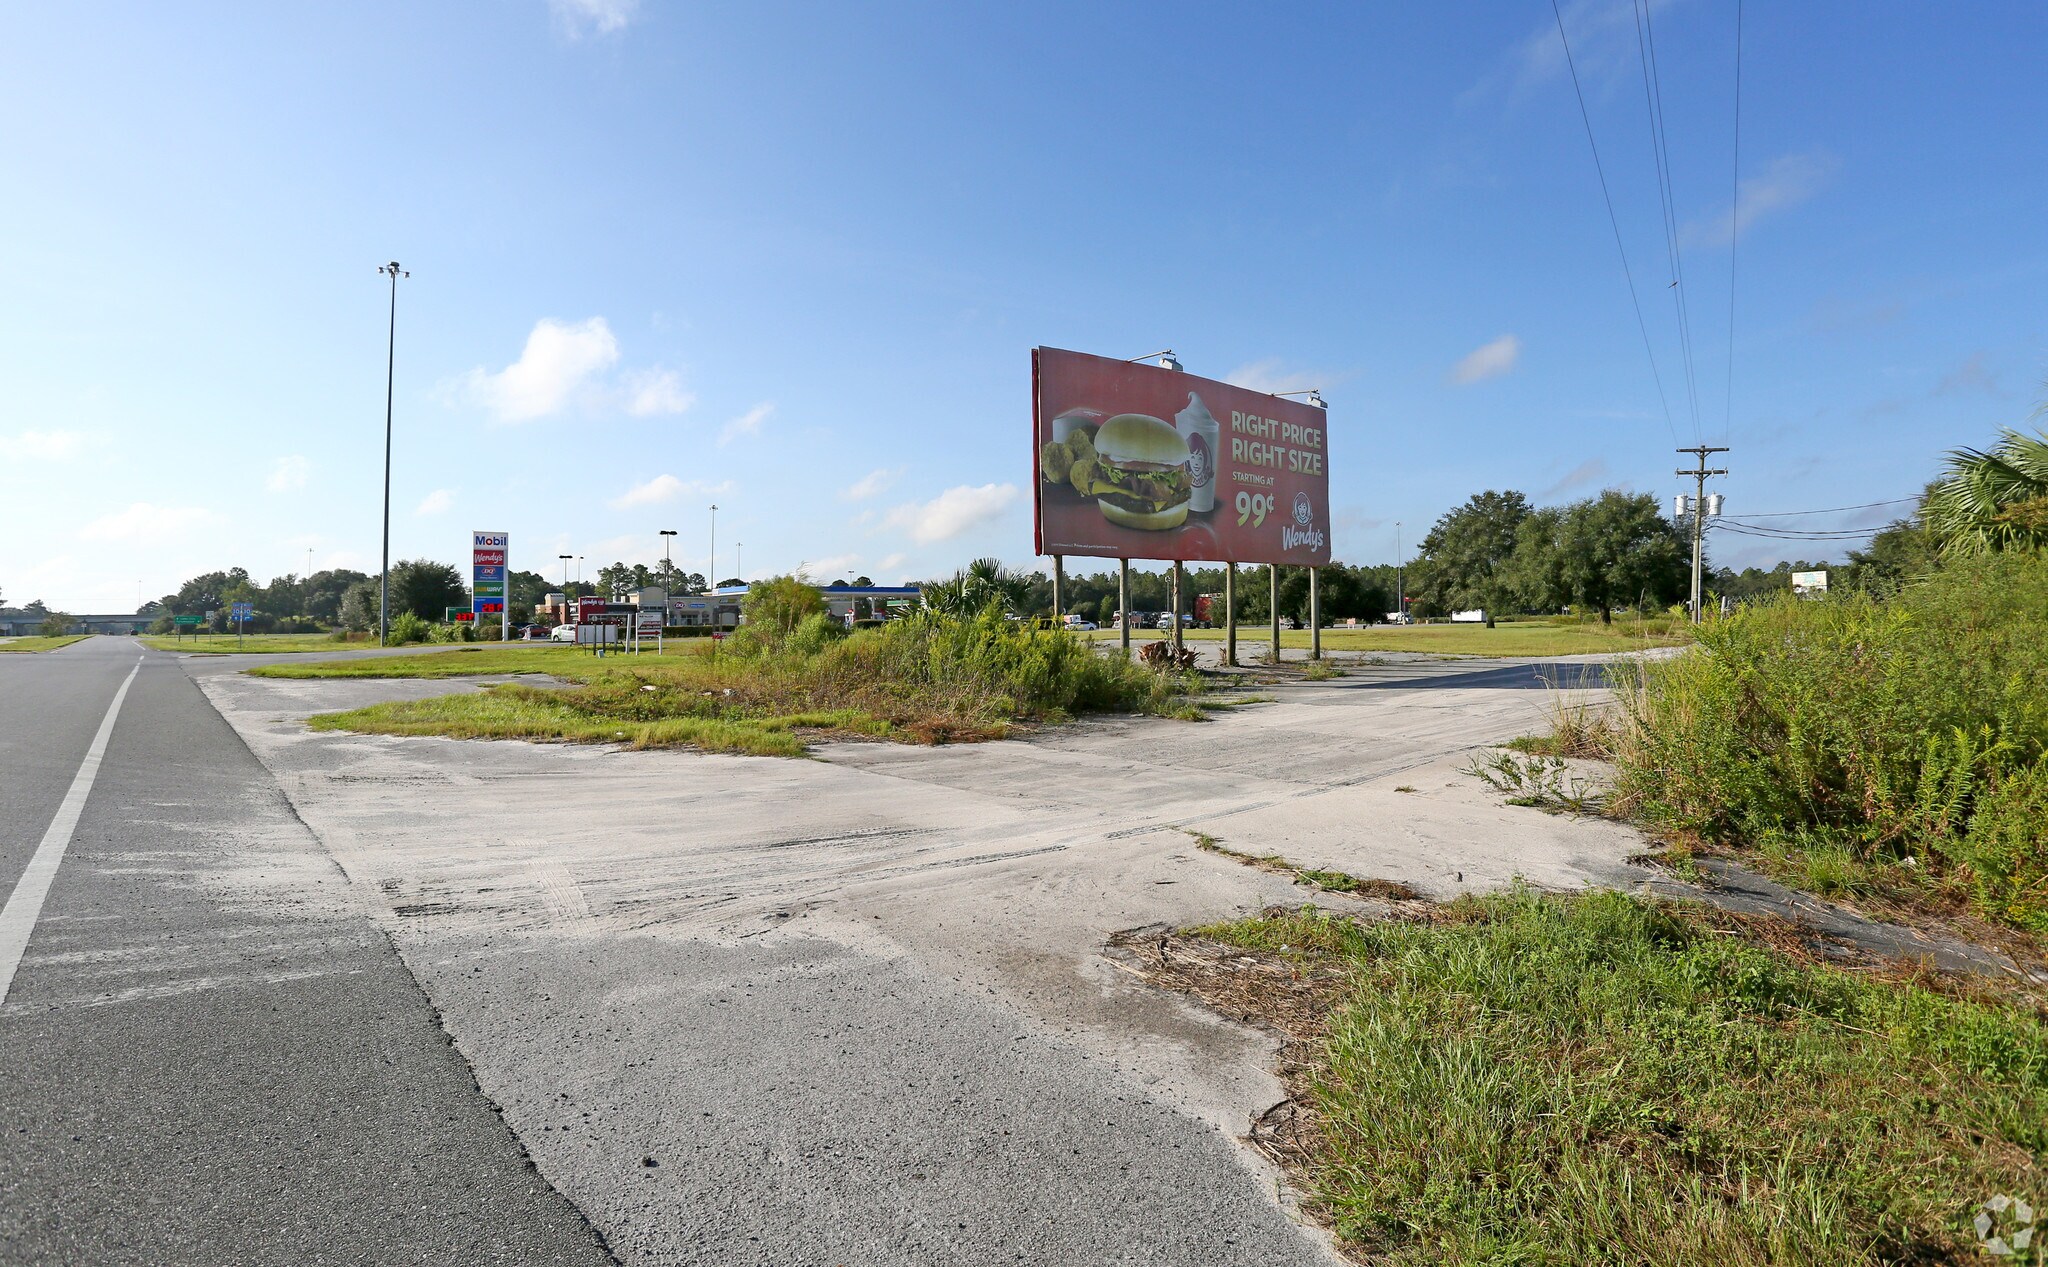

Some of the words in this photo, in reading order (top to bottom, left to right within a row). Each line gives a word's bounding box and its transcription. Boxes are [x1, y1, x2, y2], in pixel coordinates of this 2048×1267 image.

[1231, 410, 1279, 440] RIGHT
[1281, 422, 1321, 449] PRICE
[1232, 438, 1286, 470] RIGHT
[1288, 449, 1322, 476] SIZE
[1232, 471, 1265, 485] STARTING
[1266, 477, 1274, 486] AT
[1235, 491, 1275, 529] 99¢
[475, 536, 507, 546] Mobil
[1282, 523, 1324, 553] Wendy's
[474, 552, 503, 564] Wendy's
